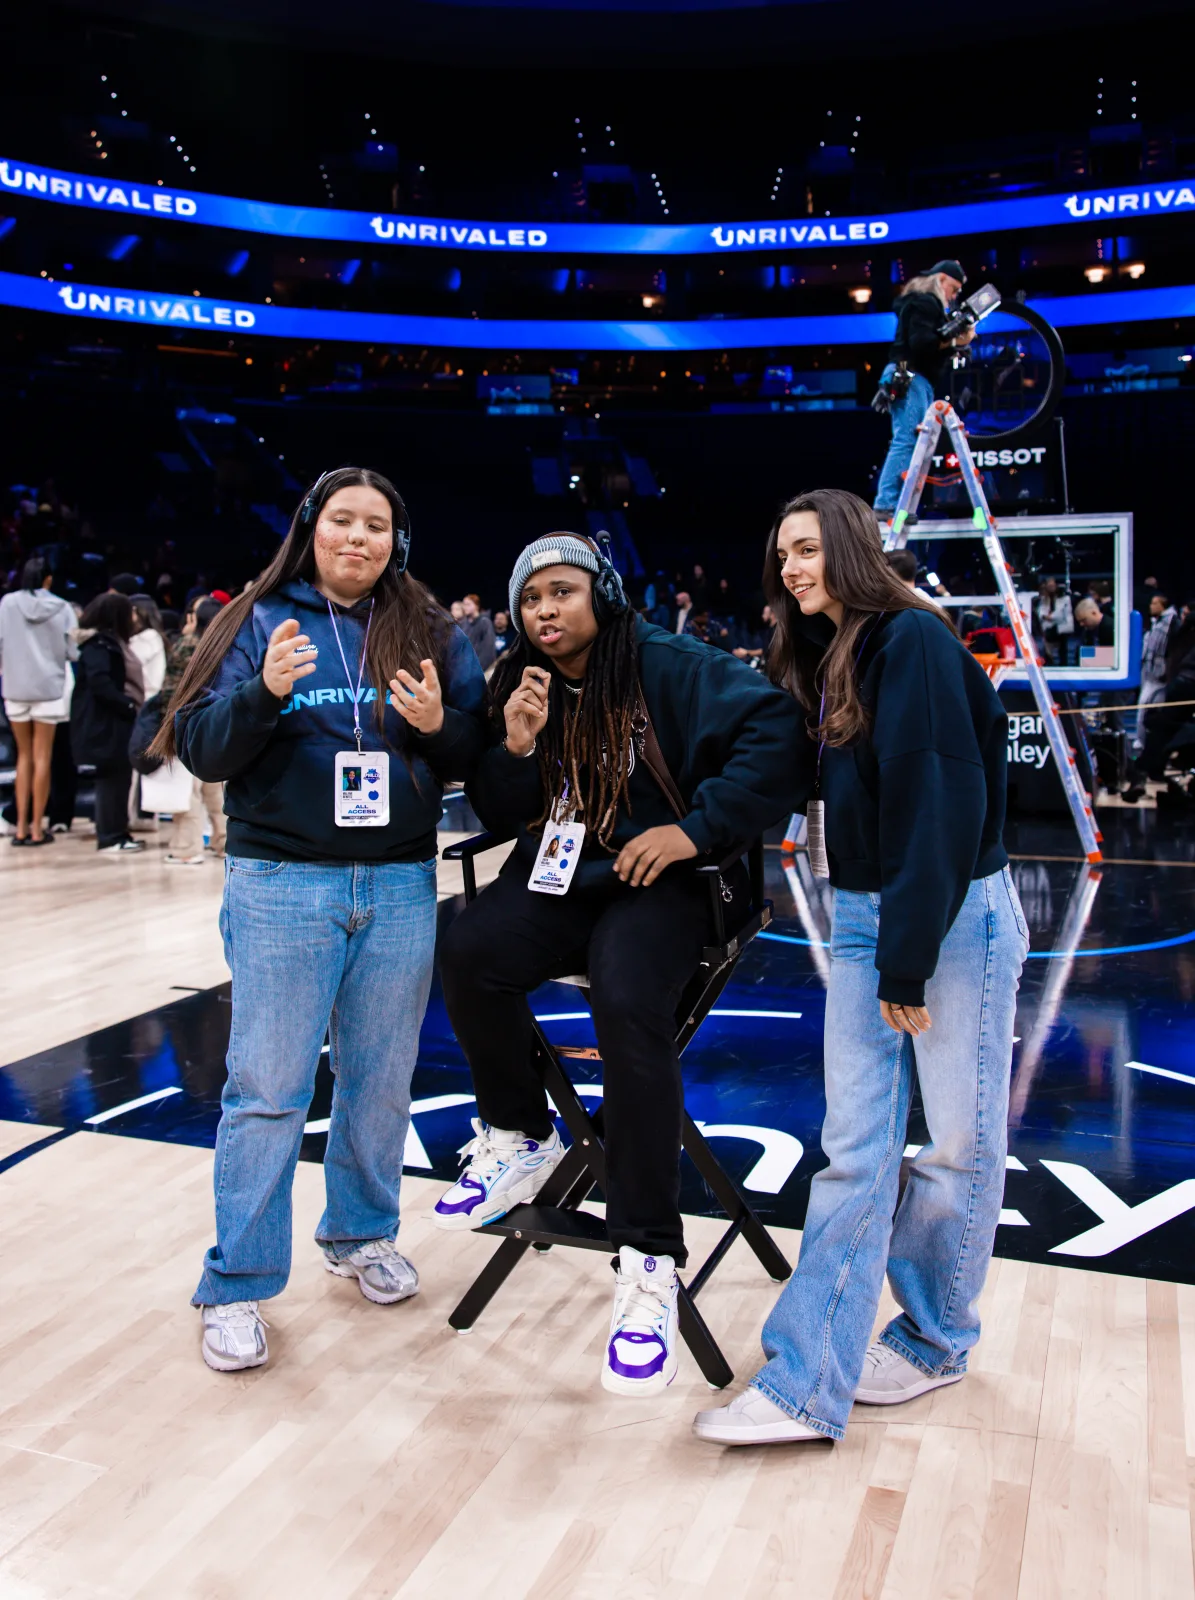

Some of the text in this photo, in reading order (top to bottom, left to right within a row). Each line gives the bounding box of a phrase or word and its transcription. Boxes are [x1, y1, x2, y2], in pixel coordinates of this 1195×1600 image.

[0, 162, 197, 216] UNRIVALED
[370, 216, 547, 246] UNRIVALED
[711, 222, 889, 246] UNRIVALED
[59, 286, 255, 328] UNRIVALED
[280, 687, 416, 715] NRIVA
